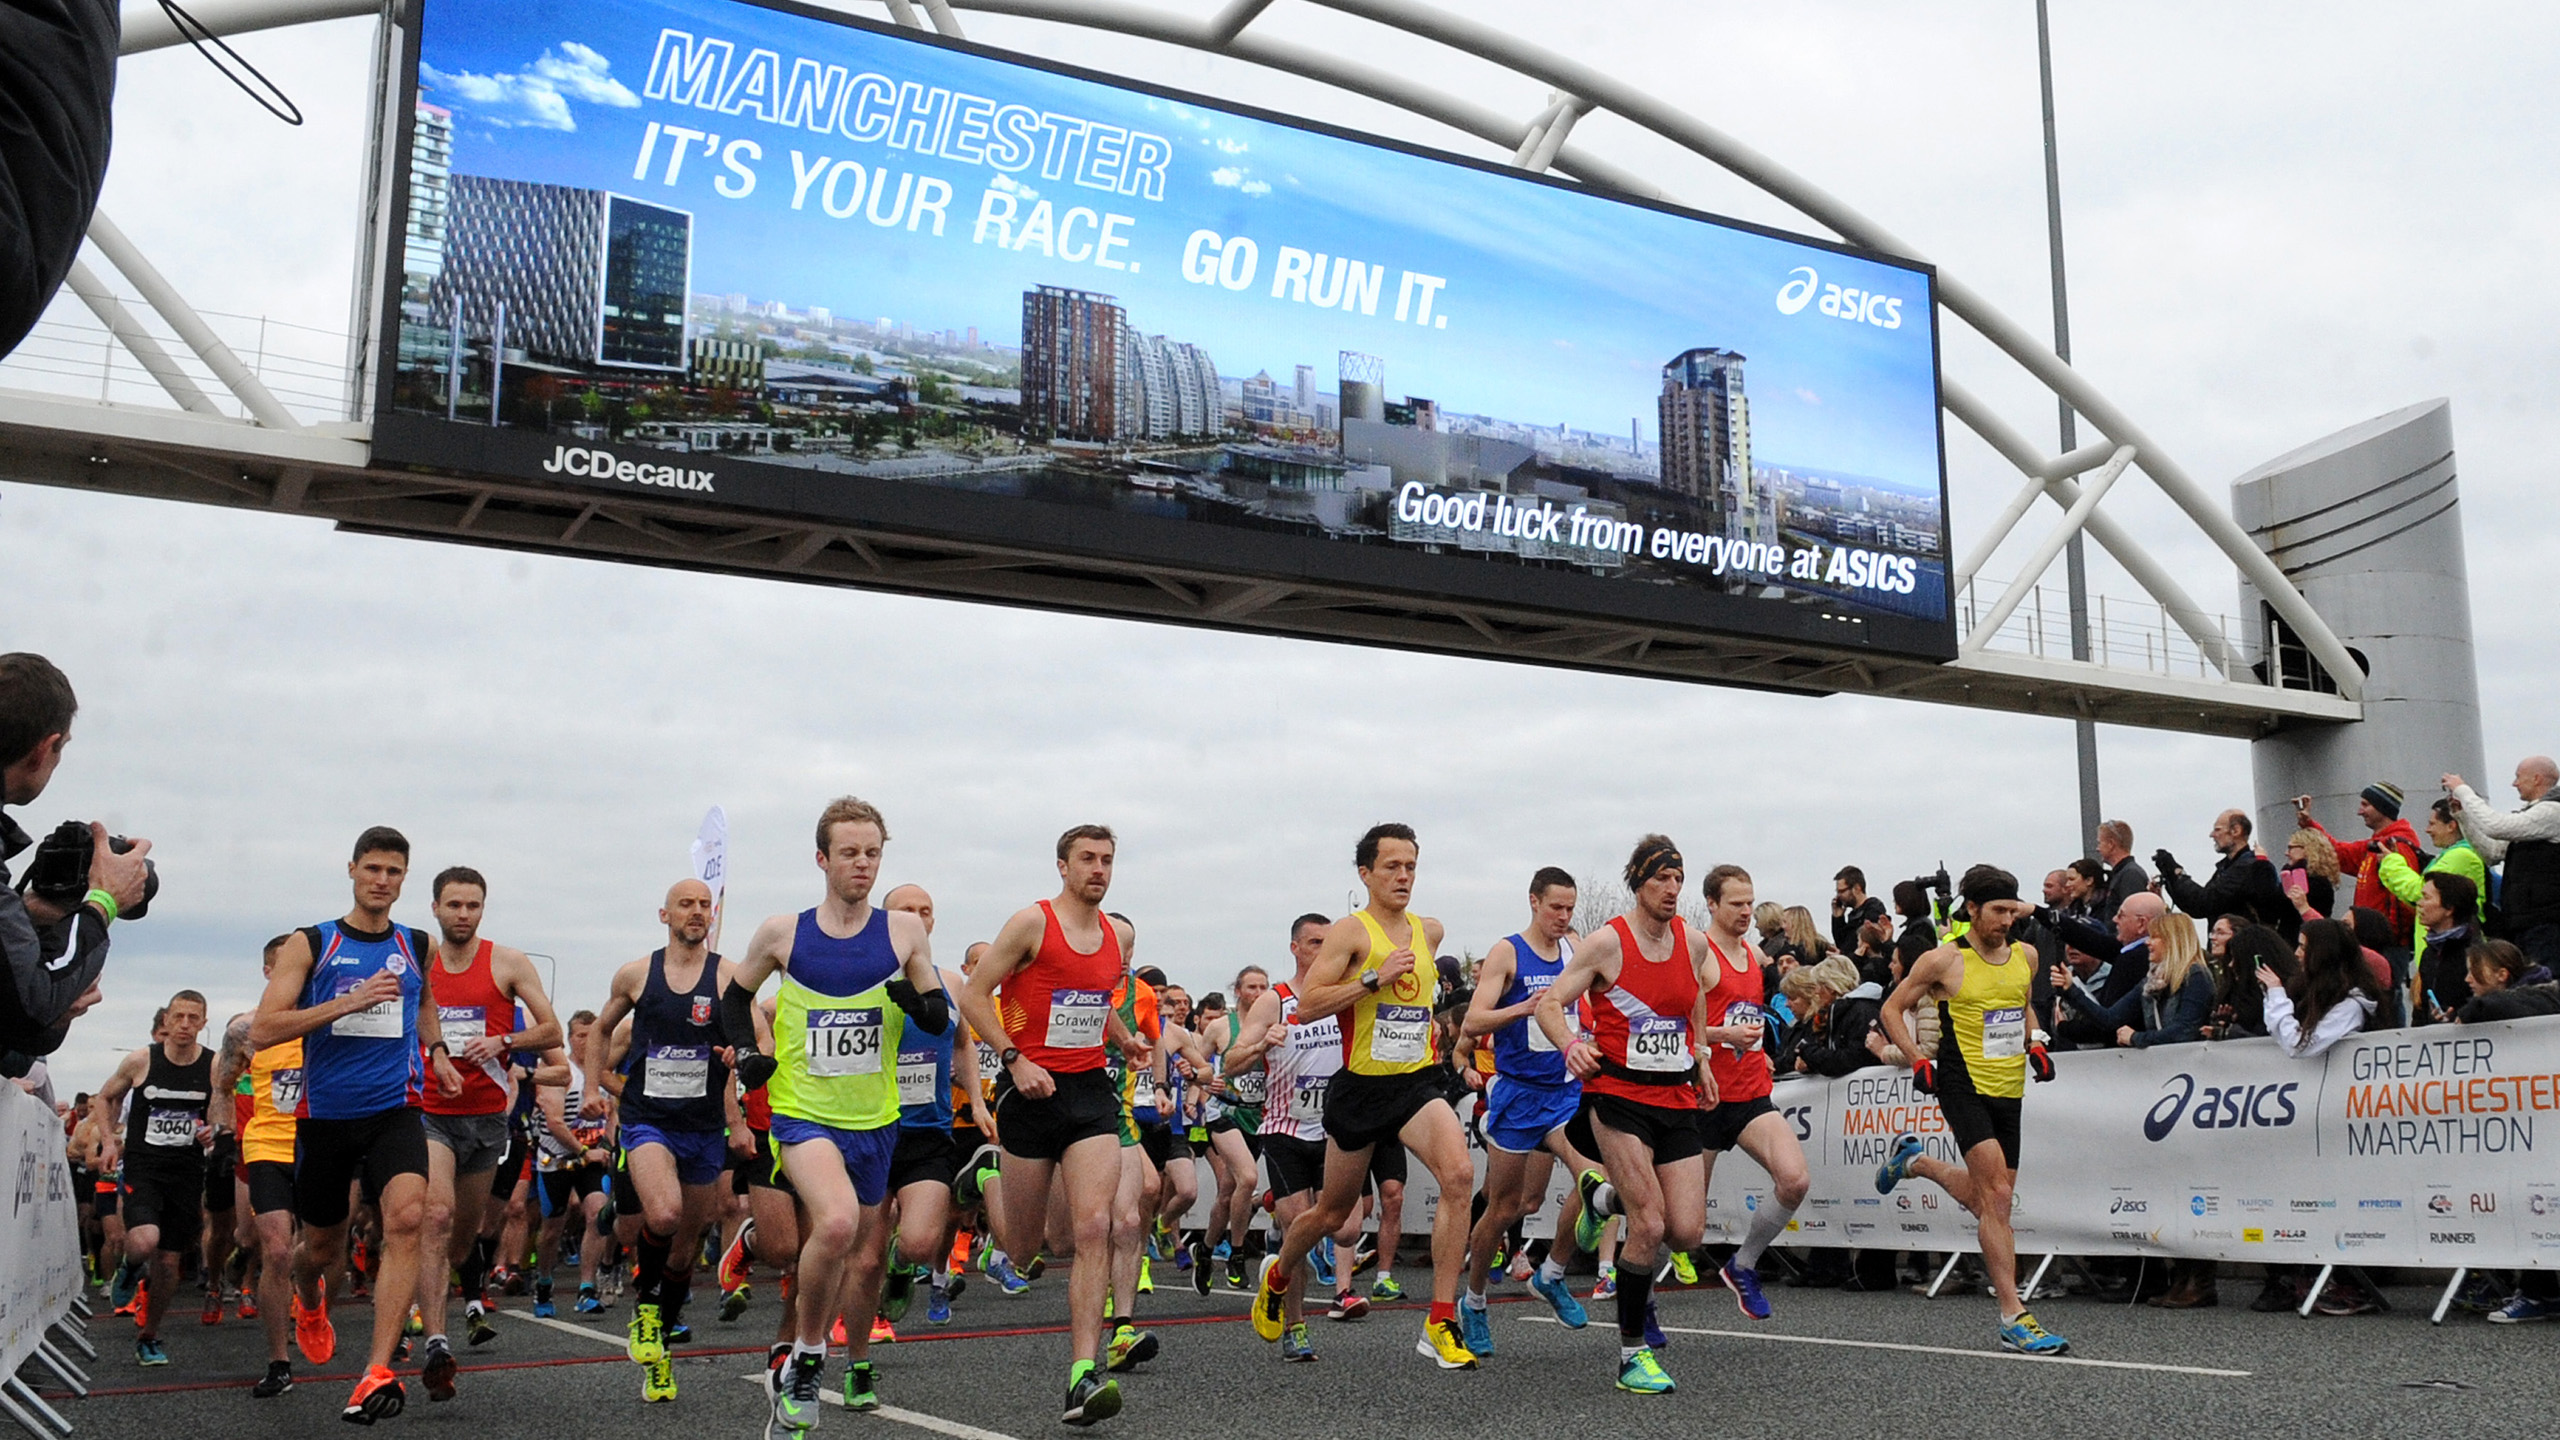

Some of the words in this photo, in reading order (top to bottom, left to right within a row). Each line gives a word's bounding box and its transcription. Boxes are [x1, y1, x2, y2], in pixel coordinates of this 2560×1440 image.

[643, 28, 1173, 202] MANCHESTER
[633, 121, 762, 200] IT'S
[789, 150, 954, 237] YOUR
[973, 188, 1141, 275] RACE.
[1181, 230, 1258, 291] GO
[1271, 247, 1384, 317] RUN
[1394, 270, 1449, 329] IT.
[1819, 284, 1903, 330] asics
[543, 445, 714, 494] JCDecaux
[1397, 481, 1484, 532] Good
[1493, 494, 1561, 545] luck
[1568, 505, 1642, 556] from
[1651, 527, 1785, 578] everyone
[1791, 546, 1821, 581] at
[1825, 547, 1917, 595] ASICS
[835, 1011, 869, 1024] asics
[1055, 1013, 1105, 1029] Crawley
[670, 1048, 697, 1059] asics
[811, 1027, 880, 1057] 11634
[1636, 1033, 1680, 1056] 6340
[648, 1067, 706, 1079] Greenwood
[2353, 1039, 2494, 1081] GREATER
[2193, 1082, 2299, 1130] asics
[153, 1119, 192, 1135] 3060
[2348, 1117, 2533, 1156] MARATHON
[2273, 1229, 2307, 1238] POLAR
[2344, 1231, 2386, 1239] manchester
